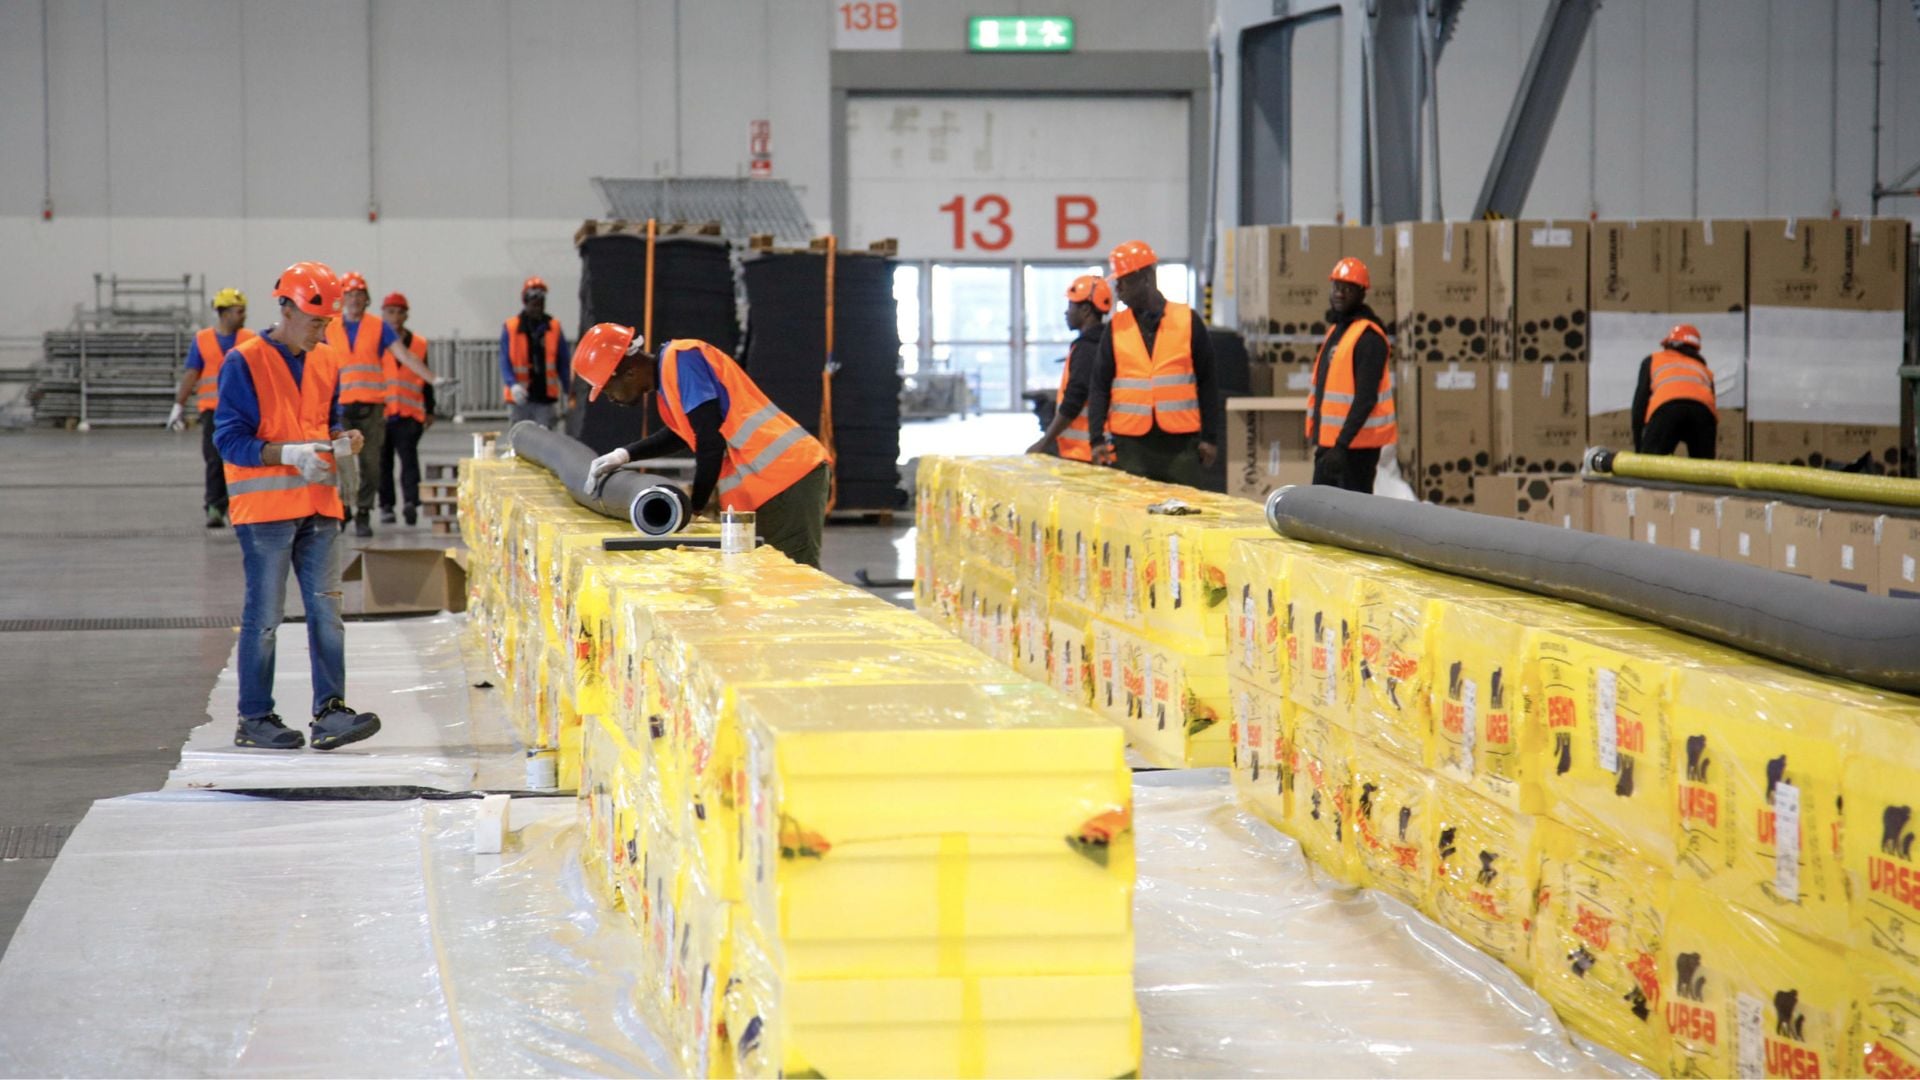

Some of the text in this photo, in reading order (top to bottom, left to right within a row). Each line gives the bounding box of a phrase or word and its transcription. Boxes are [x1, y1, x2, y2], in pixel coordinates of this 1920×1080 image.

[839, 2, 898, 31] 13B
[939, 193, 1101, 251] 13 B
